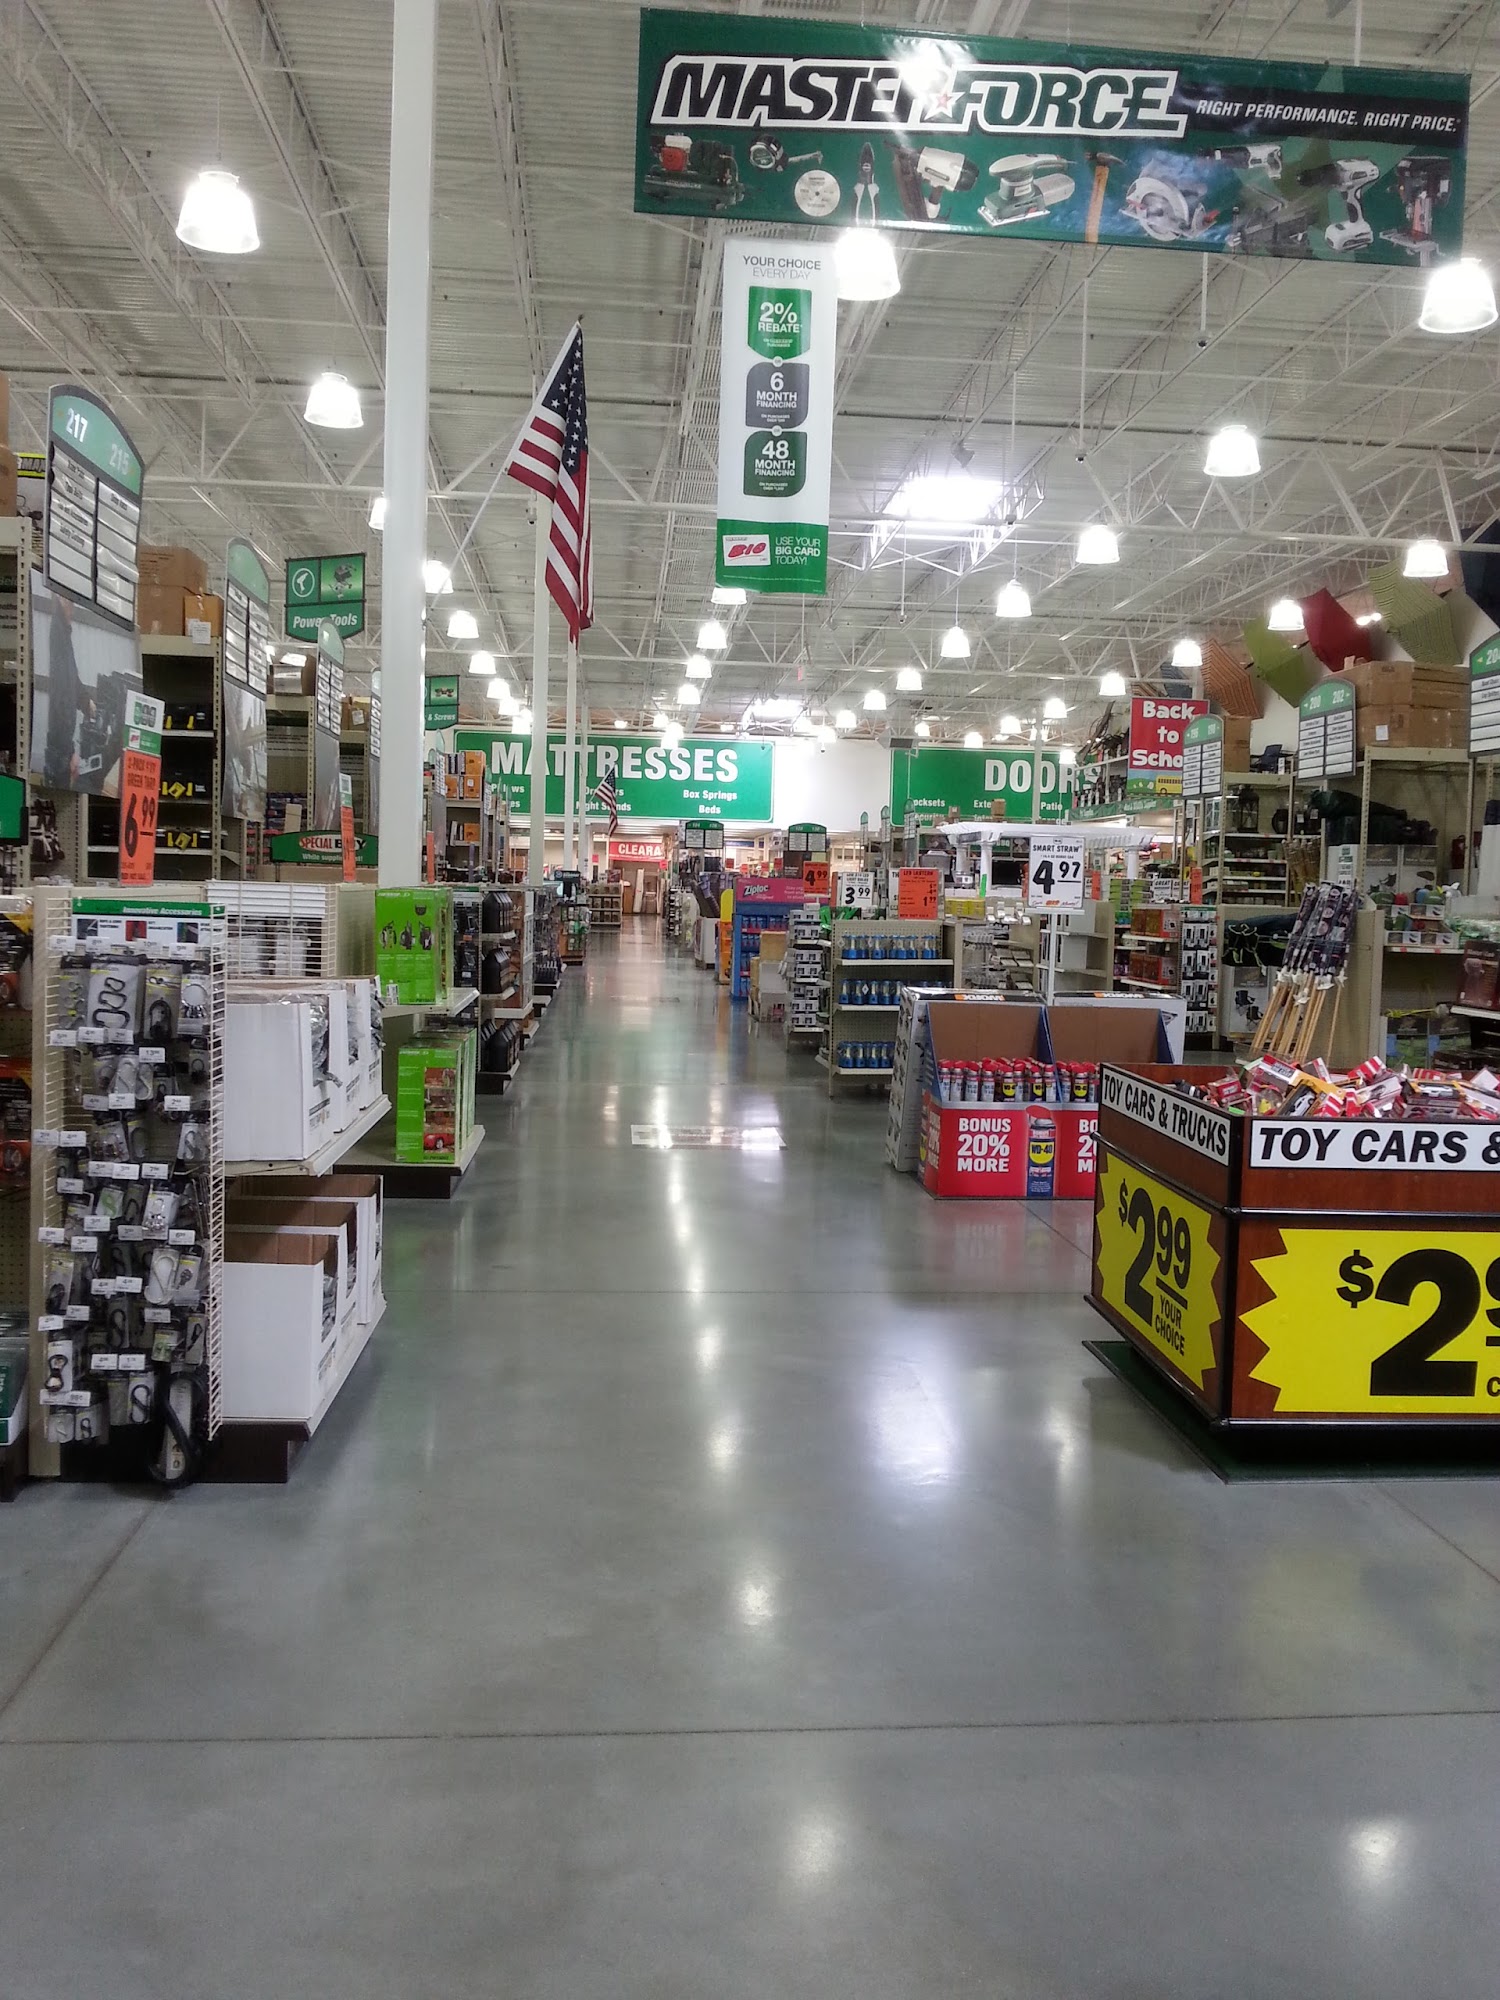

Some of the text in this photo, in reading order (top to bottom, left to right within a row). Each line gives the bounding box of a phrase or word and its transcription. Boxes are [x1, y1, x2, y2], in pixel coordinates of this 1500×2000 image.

[1196, 99, 1241, 118] RIGHT
[1244, 103, 1358, 127] PERFORMANCE.
[1363, 111, 1410, 128] RIGHT
[743, 255, 822, 271] YOUR CHOICE
[752, 266, 812, 281] EVERY DAY
[759, 301, 798, 325] 2%
[769, 371, 785, 392] 6
[756, 390, 798, 402] MONTH
[756, 400, 798, 409] FINANCING
[65, 407, 89, 443] 217
[762, 439, 790, 460] 48
[108, 443, 130, 476] 215
[754, 458, 796, 470] MONTH
[754, 468, 796, 477] FINANCING
[775, 536, 821, 548] USE YOUR
[774, 546, 821, 557] BIG CARD
[775, 556, 808, 566] TODAY!
[292, 612, 358, 629] Powe Tools
[1486, 648, 1500, 665] 20
[1142, 700, 1197, 720] Back
[1157, 726, 1180, 744] to
[491, 741, 739, 783] MTRESSES
[1132, 749, 1184, 767] Scho
[683, 789, 738, 801] Box Springs
[912, 797, 946, 808] ocksets
[698, 804, 722, 815] Beds
[1040, 801, 1063, 811] Patio
[124, 792, 139, 858] 6
[300, 837, 366, 850] SPECIAL BY
[618, 843, 663, 856] CLEARA
[1032, 844, 1080, 853] SMART STRAW
[302, 853, 320, 861] While
[1032, 860, 1081, 895] 4 97
[743, 884, 770, 898] Ziploc
[123, 906, 203, 916] Innovative Accessories
[1104, 1074, 1228, 1157] TOY CARS & TRUCKS
[959, 1117, 1012, 1133] BONUS
[957, 1133, 1011, 1158] 20%
[1030, 1144, 1053, 1155] WD-40
[1259, 1127, 1341, 1162] TOY
[1351, 1129, 1469, 1164] CARS
[957, 1157, 1010, 1173] MORE
[1159, 1294, 1183, 1330] YOUR
[1154, 1314, 1186, 1357] CHOICE
